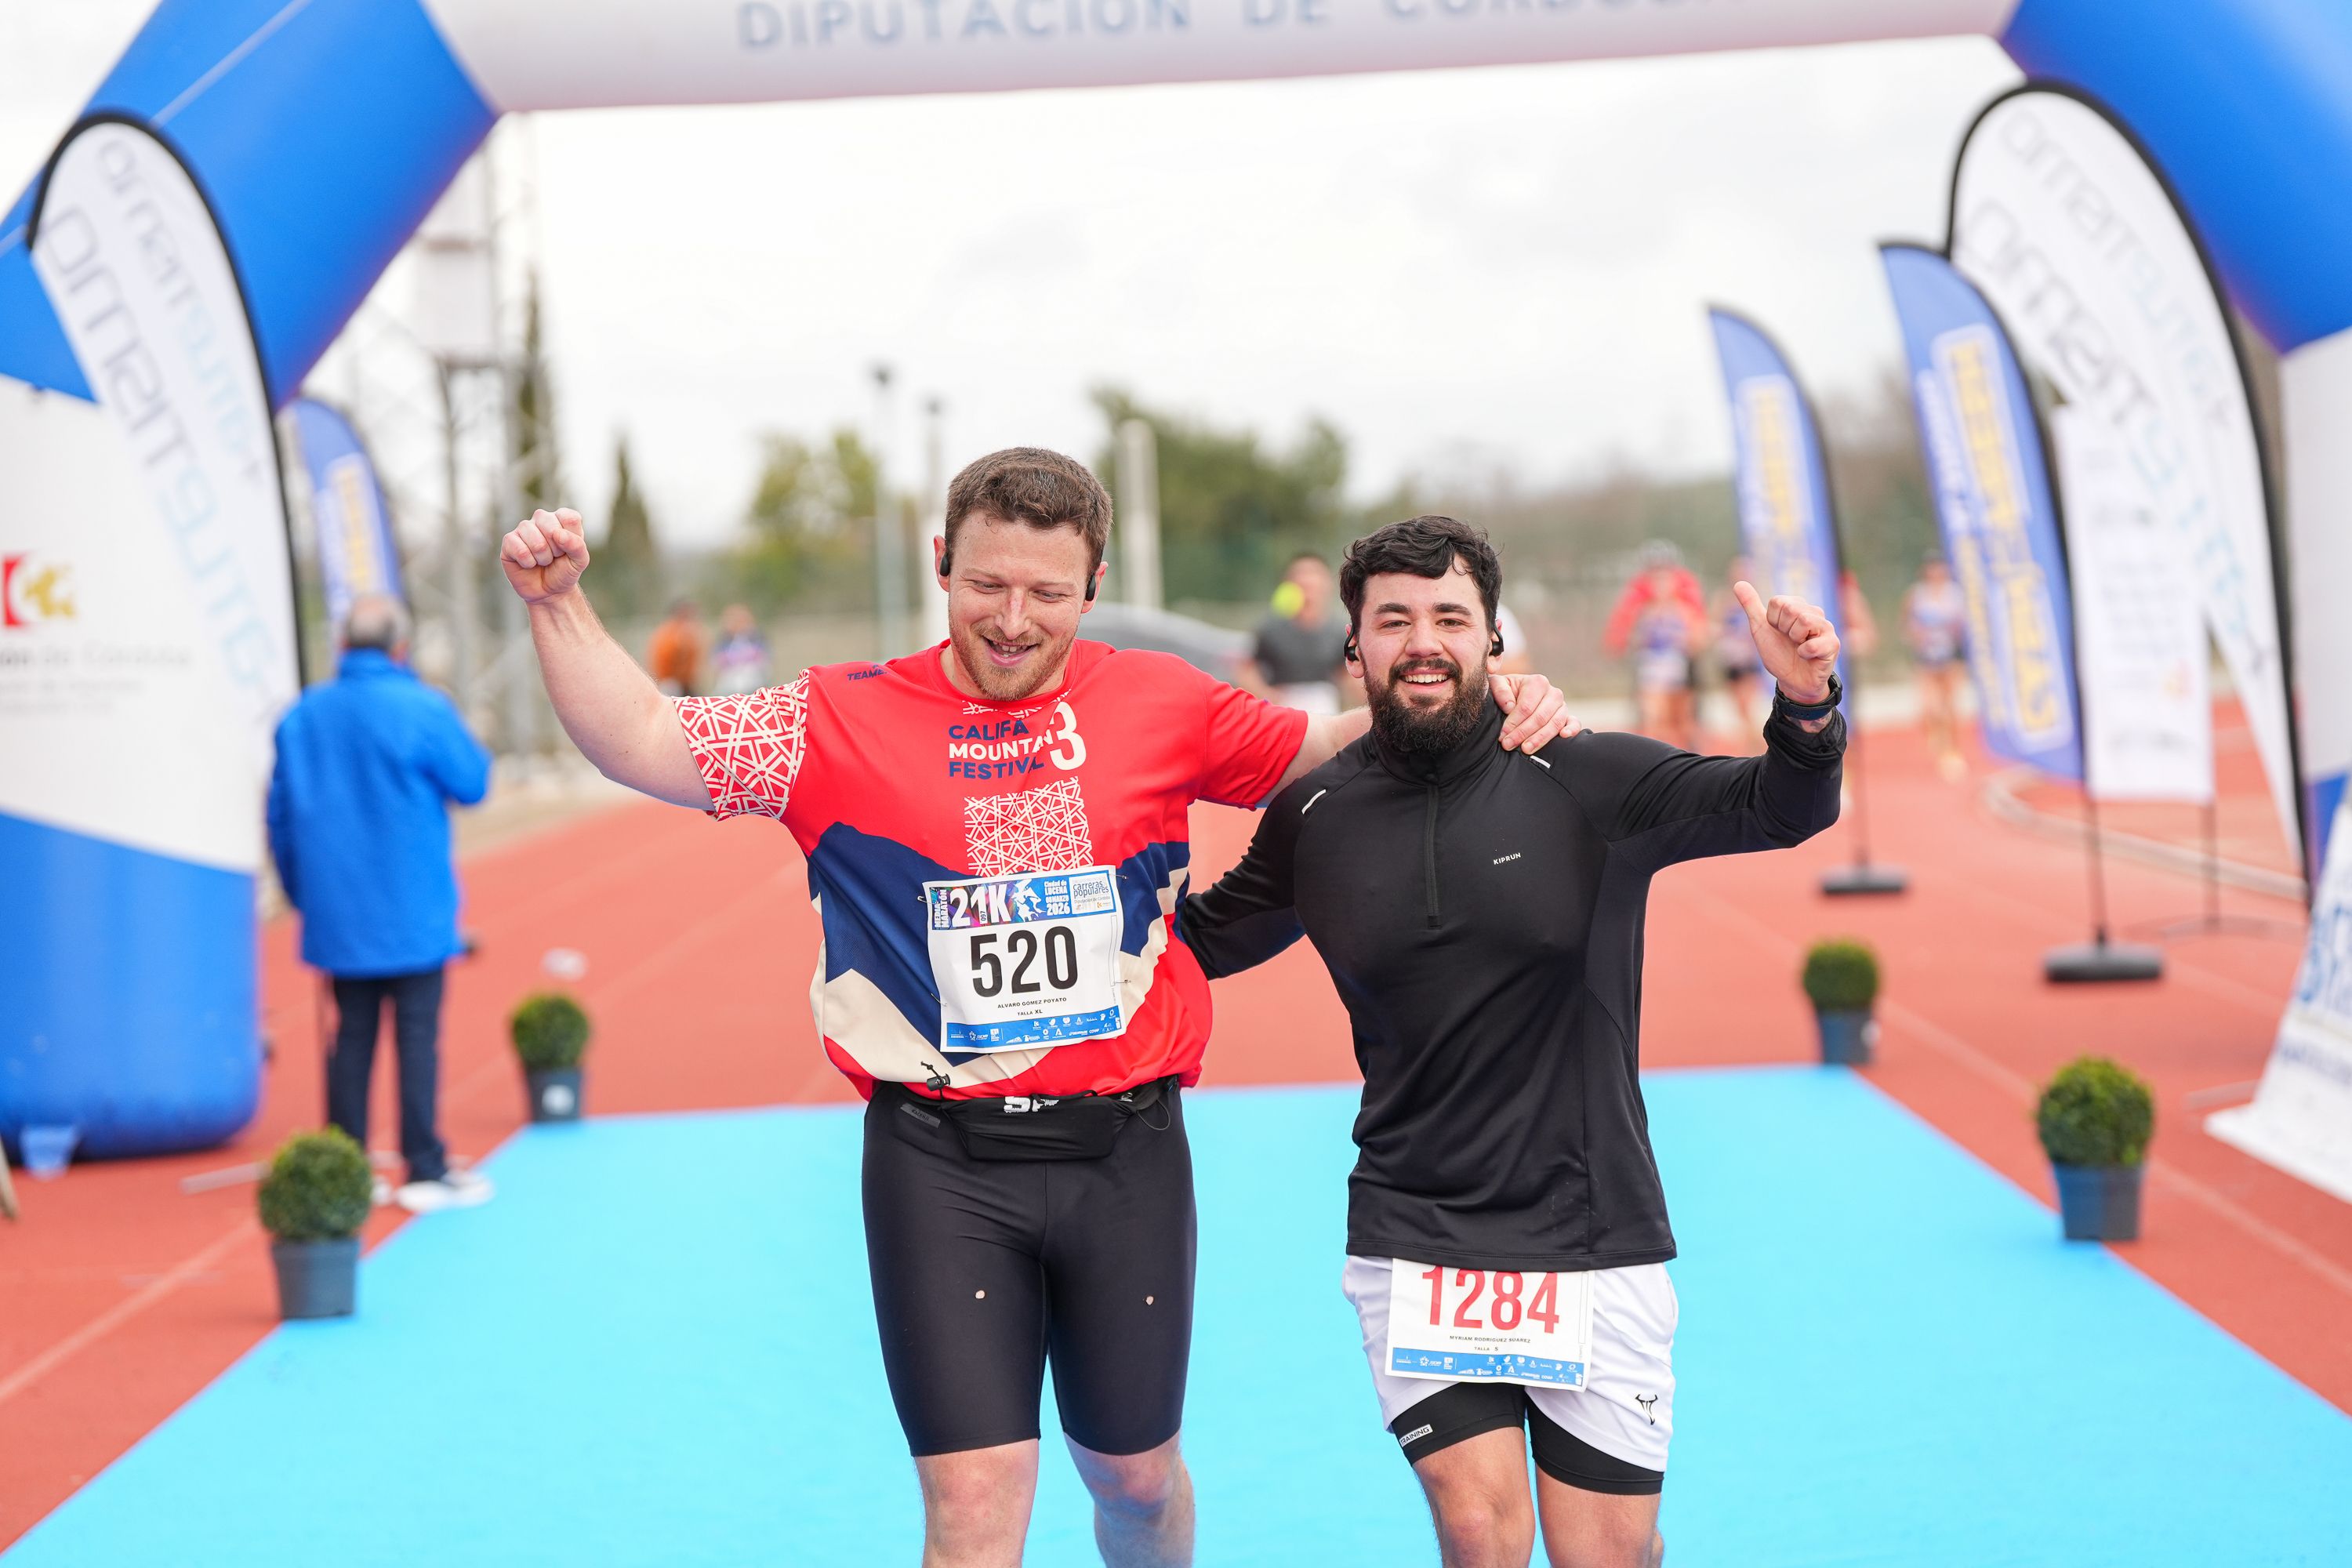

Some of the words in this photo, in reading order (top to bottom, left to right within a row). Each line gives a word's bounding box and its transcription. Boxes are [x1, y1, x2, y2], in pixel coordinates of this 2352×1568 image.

[949, 720, 1029, 741] CALIFA
[1049, 701, 1087, 771] 3
[949, 729, 1054, 761] MOUNTAN
[949, 757, 1044, 779] FESTIVL
[1493, 852, 1522, 865] KIPRUN
[1044, 886, 1068, 895] LUCENA
[1073, 880, 1103, 891] carreras
[1073, 886, 1109, 899] populares
[949, 884, 1012, 927] 21K
[1047, 902, 1070, 916] 2026
[971, 926, 1078, 998] 520
[1422, 1265, 1560, 1334] 1284
